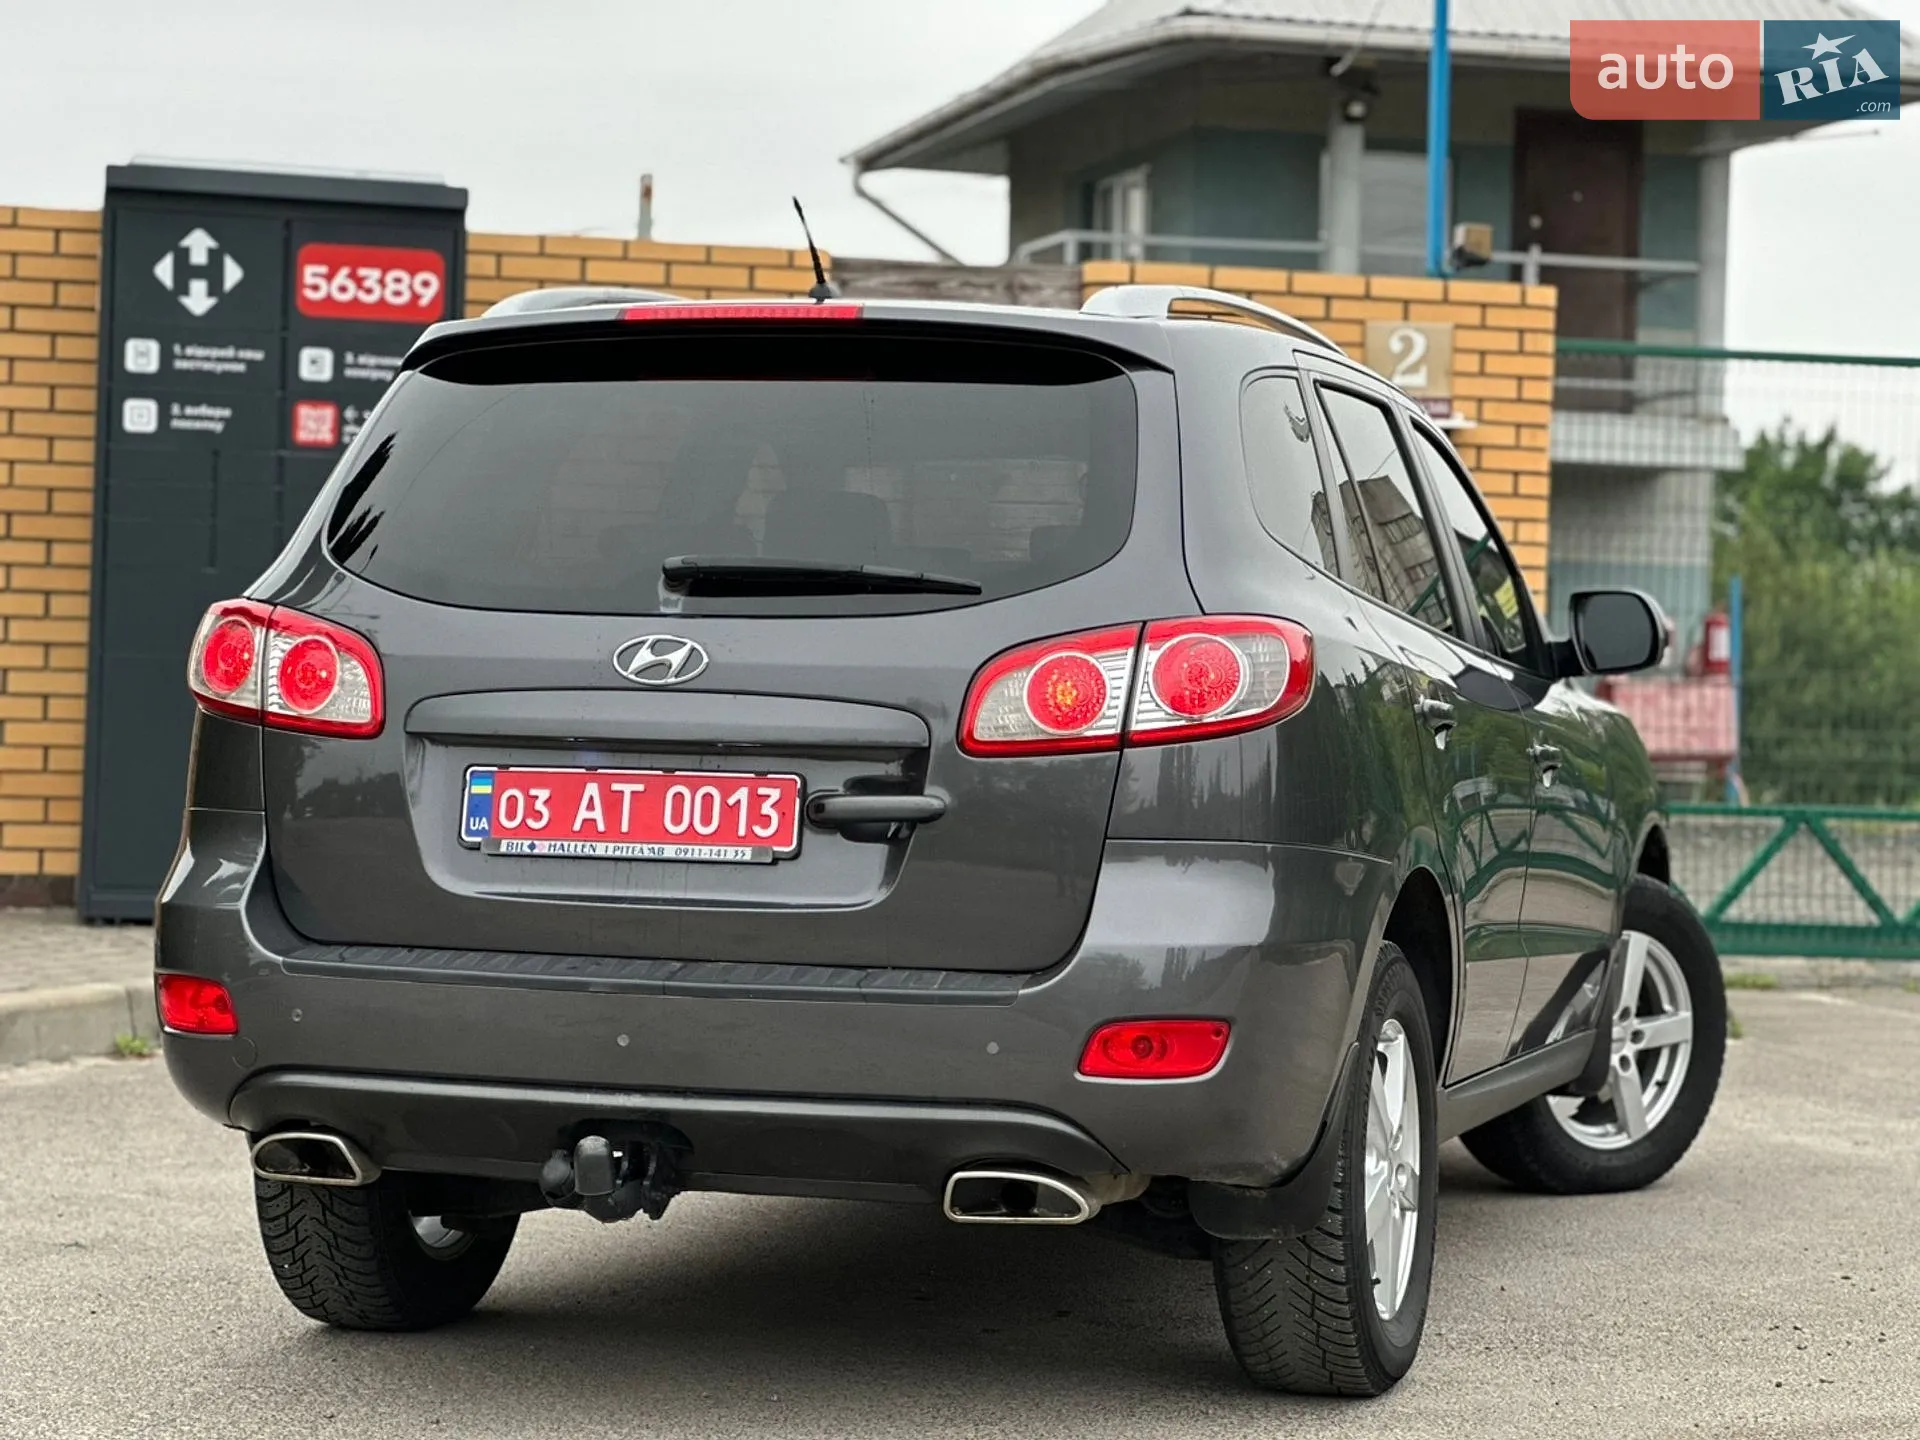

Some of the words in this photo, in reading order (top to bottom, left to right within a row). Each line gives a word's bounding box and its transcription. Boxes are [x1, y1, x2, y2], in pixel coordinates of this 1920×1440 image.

[301, 263, 440, 308] 56389
[1388, 327, 1428, 388] 2
[469, 816, 489, 832] UA
[498, 787, 552, 830] 03
[571, 781, 646, 834] AT
[663, 783, 781, 838] 0013
